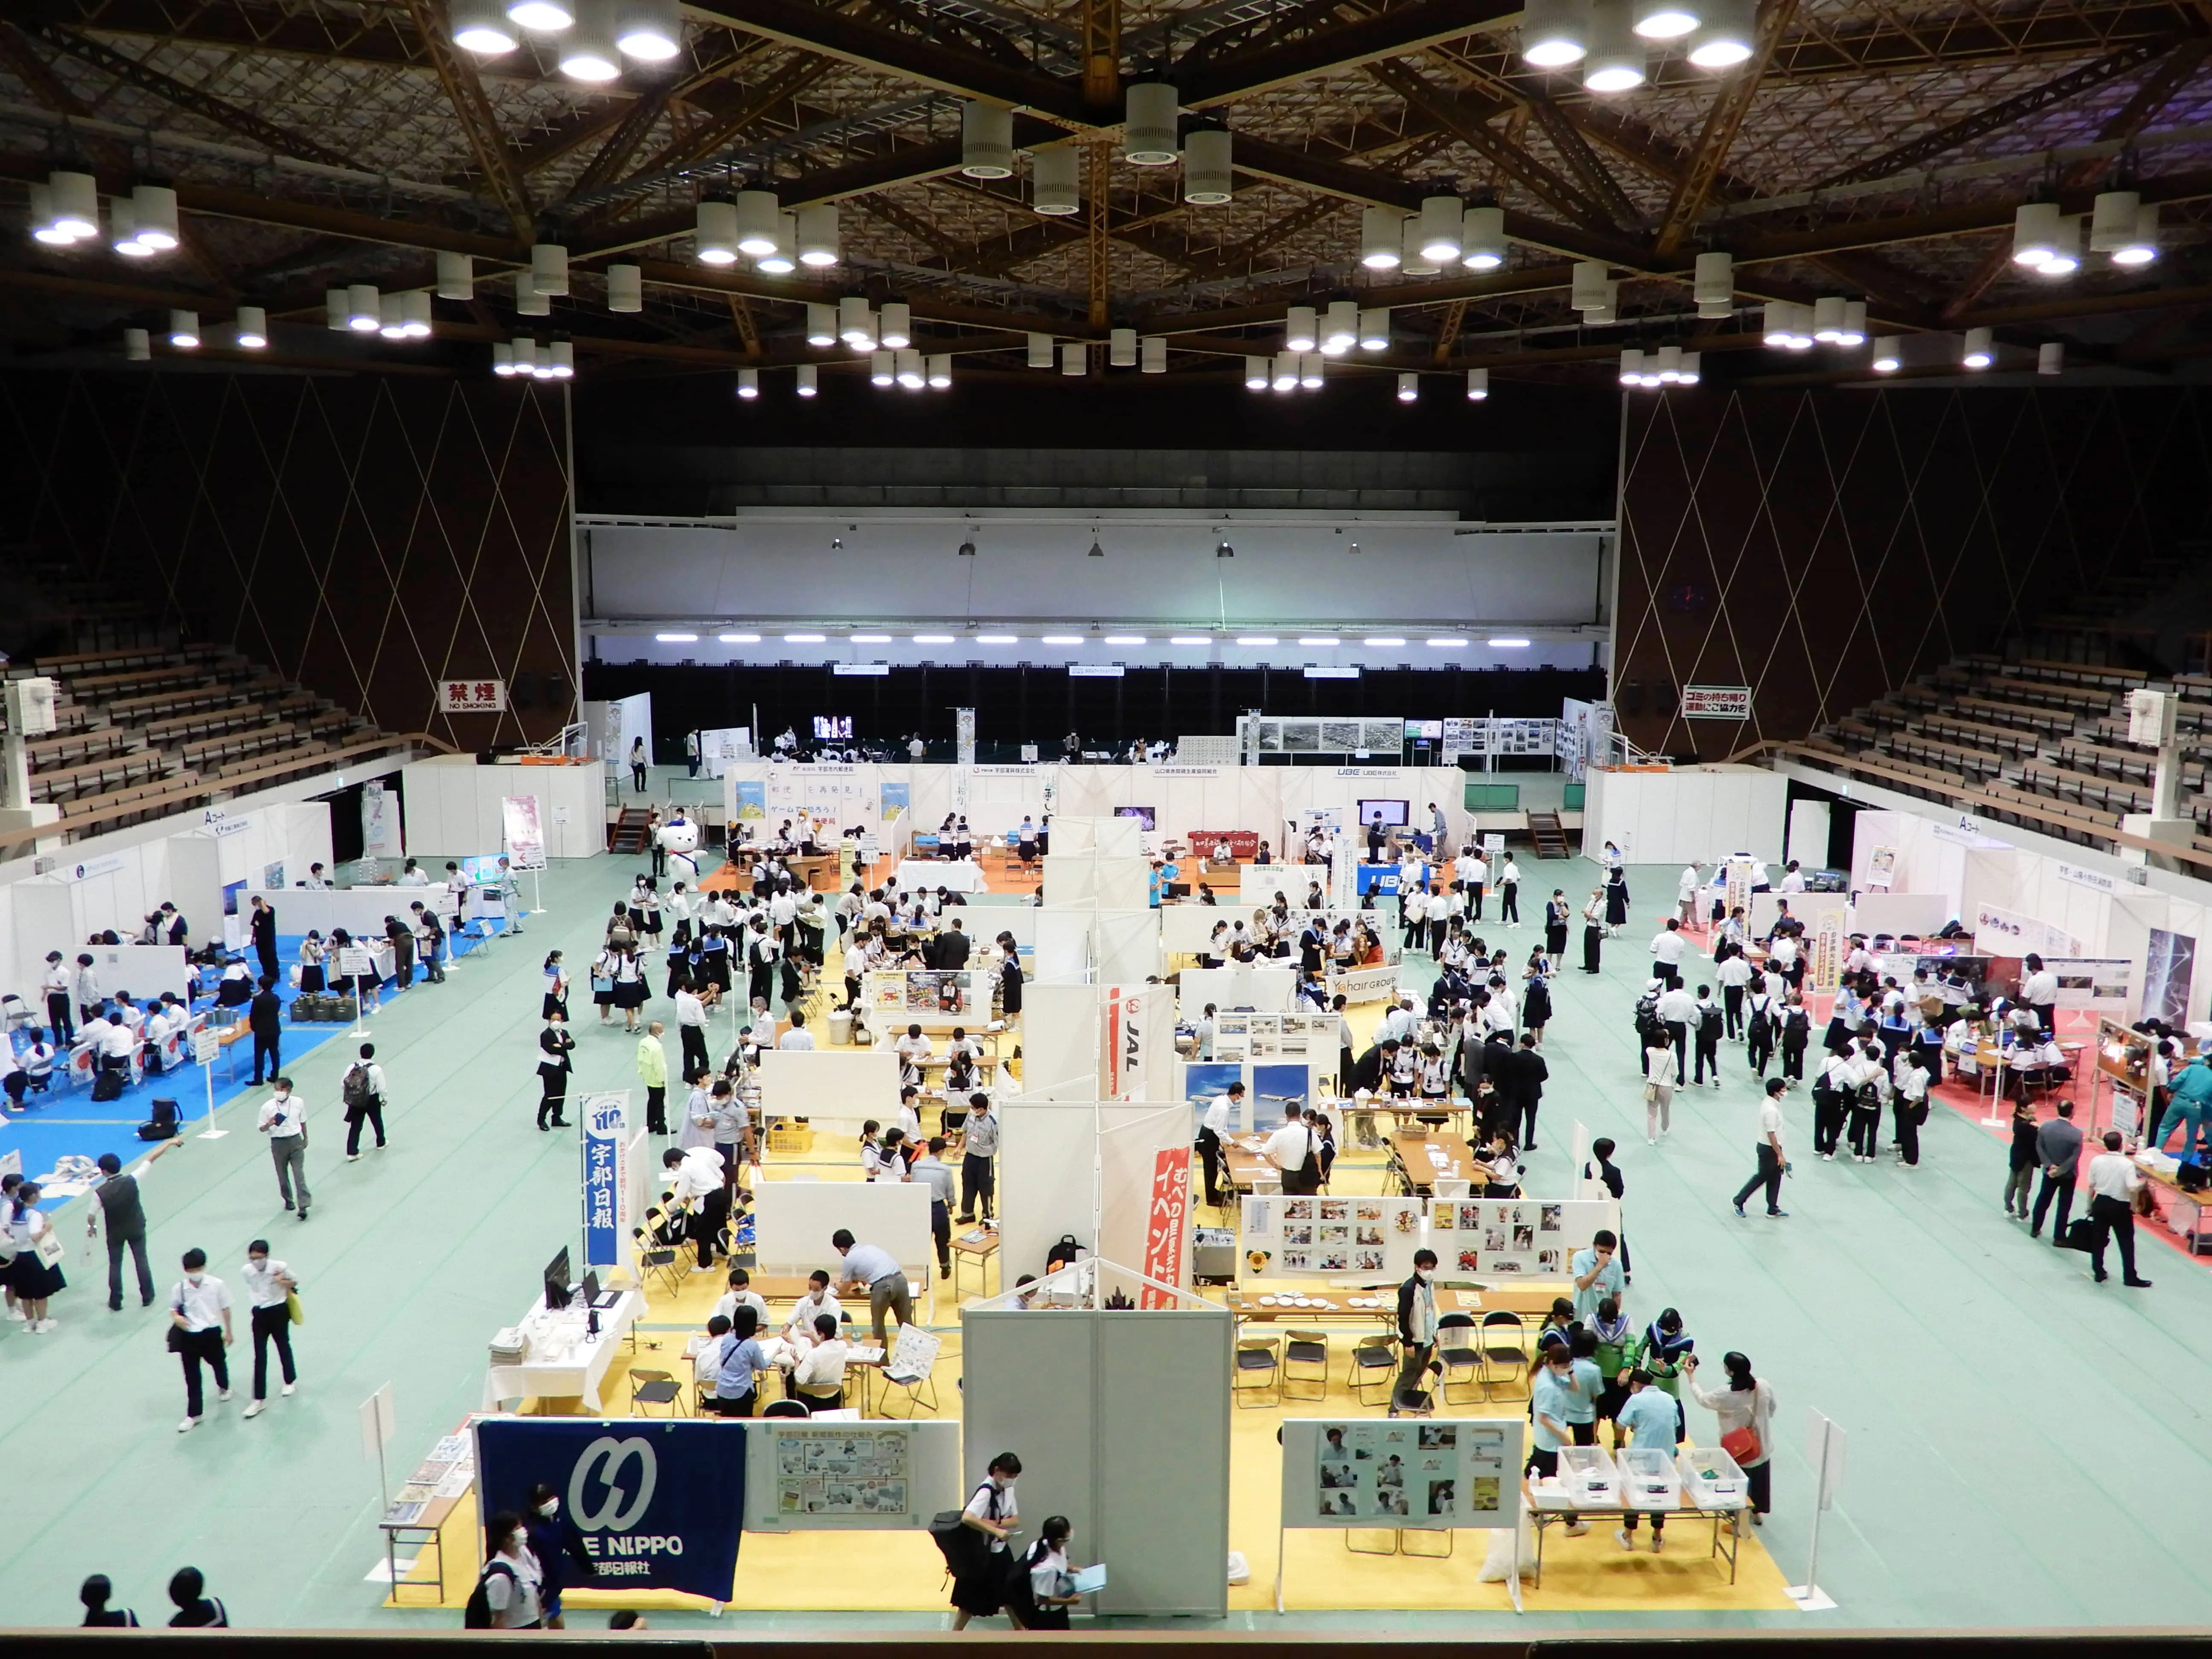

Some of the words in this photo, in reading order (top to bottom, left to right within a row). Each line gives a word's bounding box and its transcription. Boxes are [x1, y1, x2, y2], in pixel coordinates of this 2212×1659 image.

[448, 683, 496, 702] 禁煙
[1686, 691, 1746, 702] ゴミの持ち帰り
[1685, 702, 1746, 713] 運動にご協力を
[1370, 875, 1401, 888] UB
[1369, 977, 1396, 989] GROUP
[1126, 1020, 1139, 1072] JAL
[589, 1144, 614, 1229] 宇部日報
[607, 1536, 683, 1556] NIPPO
